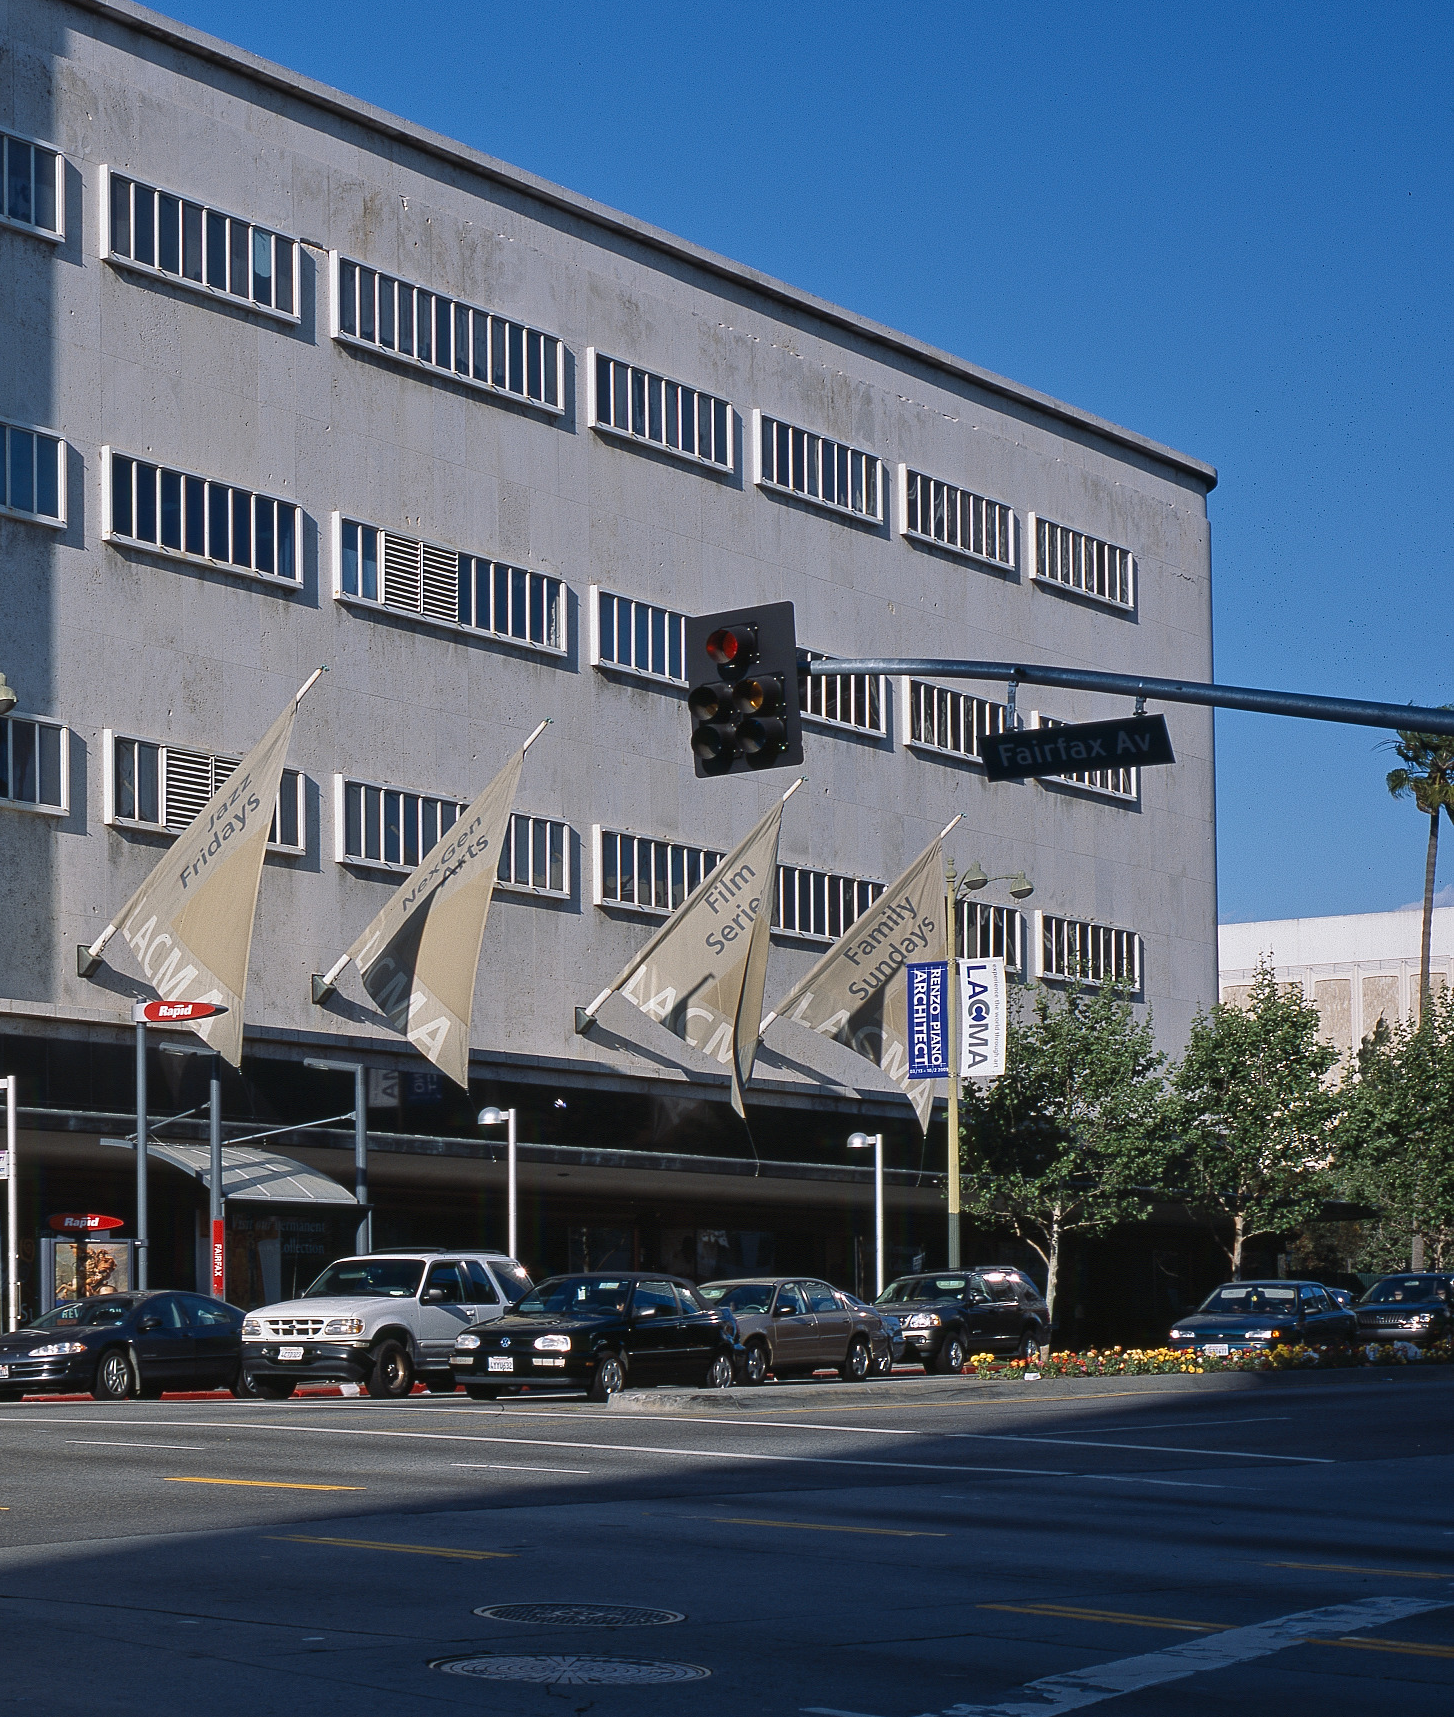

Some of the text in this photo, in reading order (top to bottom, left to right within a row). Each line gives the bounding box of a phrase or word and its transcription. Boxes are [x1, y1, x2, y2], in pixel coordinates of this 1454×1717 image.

[998, 730, 1152, 768] Fairfax Av
[207, 773, 252, 833] Jazz
[179, 792, 261, 889] Fridays
[402, 815, 483, 913] NexGen
[442, 834, 489, 888] Arts
[704, 864, 757, 915] Film
[705, 893, 762, 956] Serie
[842, 895, 918, 966] Family
[848, 916, 936, 1001] Sundays
[992, 964, 1000, 999] experience
[158, 1003, 193, 1018] Rapid
[621, 964, 734, 1064] LACM
[913, 970, 928, 1066] ARCHITECT
[930, 968, 943, 1066] RENZO PIANO
[967, 965, 990, 1069] LACMA
[992, 1031, 1000, 1057] through
[64, 1217, 100, 1229] Rapid
[214, 1244, 223, 1277] FAIRFAX
